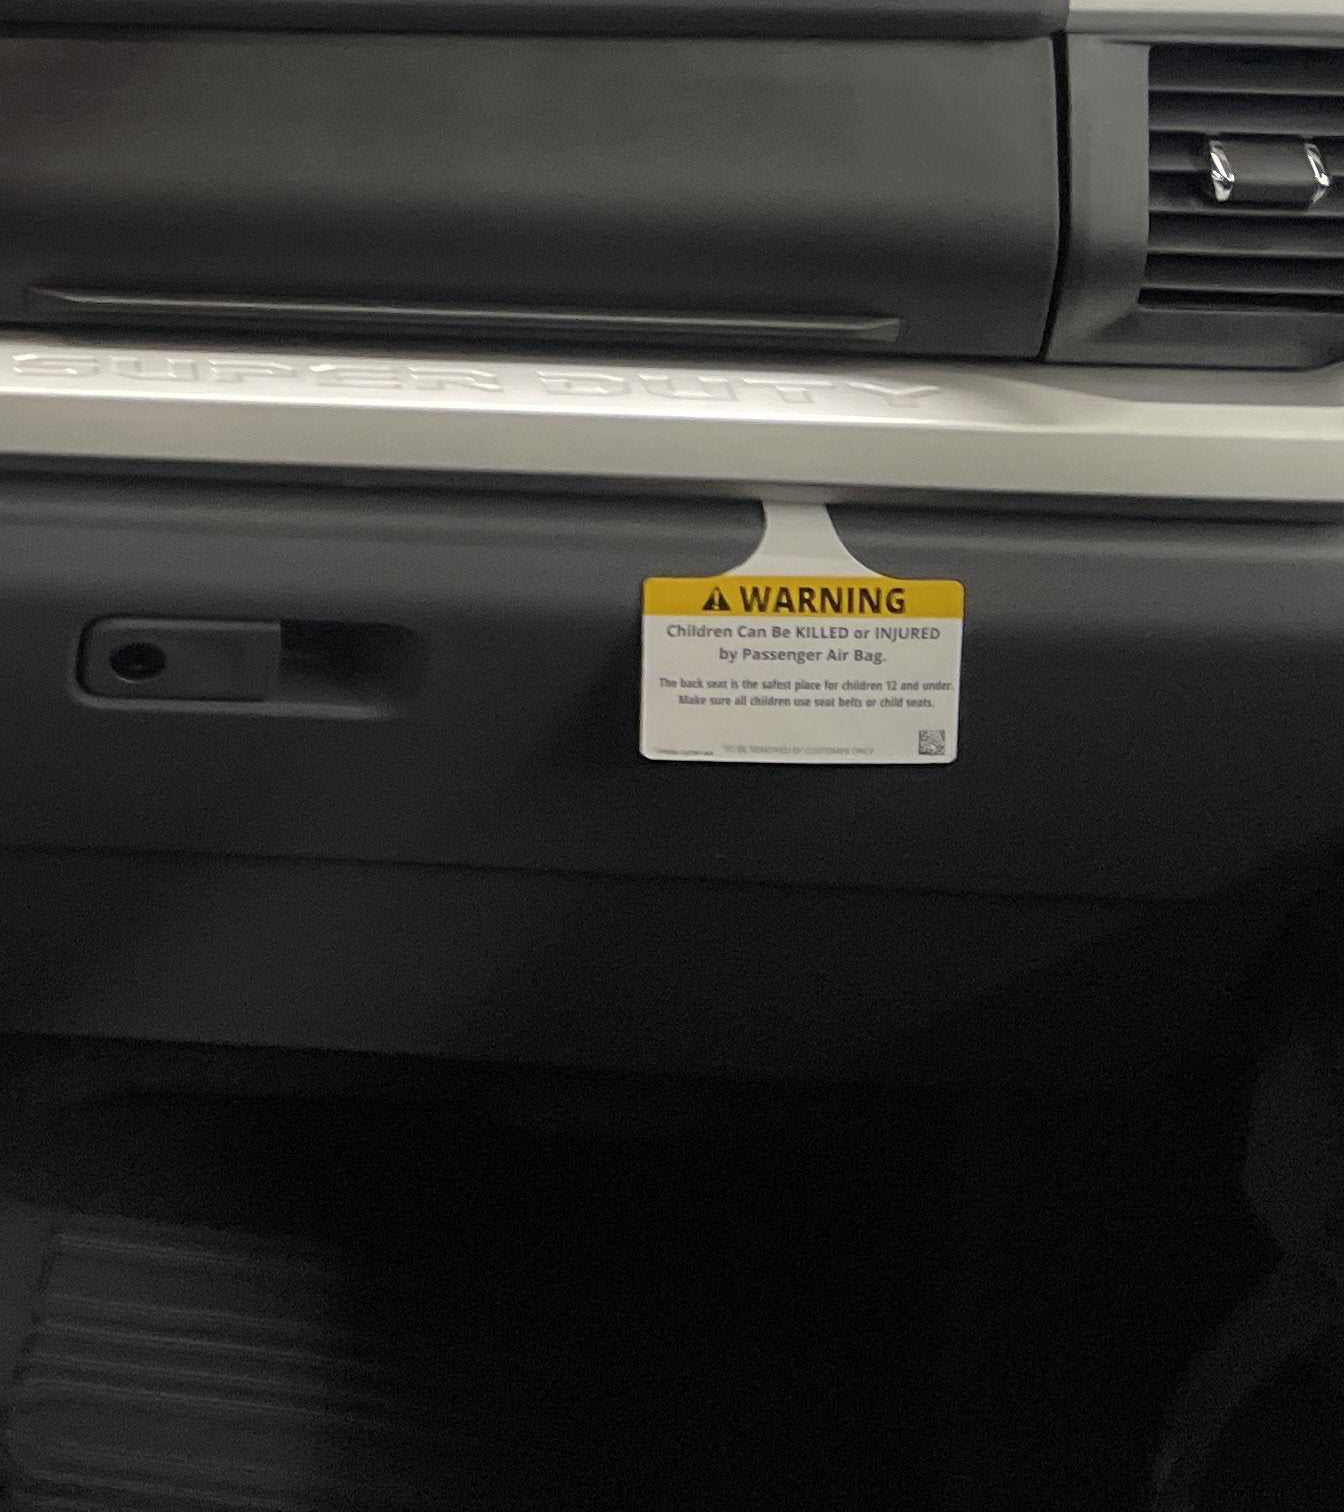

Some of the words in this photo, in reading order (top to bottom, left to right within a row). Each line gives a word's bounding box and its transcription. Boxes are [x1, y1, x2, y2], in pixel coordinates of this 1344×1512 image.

[11, 353, 504, 392] SUPER
[534, 370, 941, 408] DUTY
[739, 585, 906, 614] WARNING
[666, 624, 733, 638] Children
[737, 625, 767, 638] Can
[771, 626, 791, 638] Be
[796, 626, 849, 639] KILLED
[853, 628, 870, 639] or
[875, 626, 941, 643] INJURED
[718, 647, 738, 663] by
[742, 648, 823, 664] Passenger
[826, 648, 849, 661] Air
[854, 649, 887, 665] Bag.
[659, 677, 677, 688] The
[680, 677, 703, 688] back
[706, 679, 727, 689] seat
[730, 678, 738, 689] is
[742, 678, 758, 689] the
[761, 678, 791, 690] safest
[794, 679, 821, 692] place
[824, 679, 840, 690] for
[841, 679, 883, 691] children
[886, 680, 898, 691] 12
[900, 680, 919, 691] and
[678, 694, 707, 705] Make
[710, 696, 731, 706] sure
[734, 695, 747, 706] all
[750, 695, 790, 707] children
[793, 697, 811, 707] use
[814, 697, 835, 707] seat
[838, 696, 862, 708] belts
[865, 698, 877, 708] or
[879, 697, 904, 708] child
